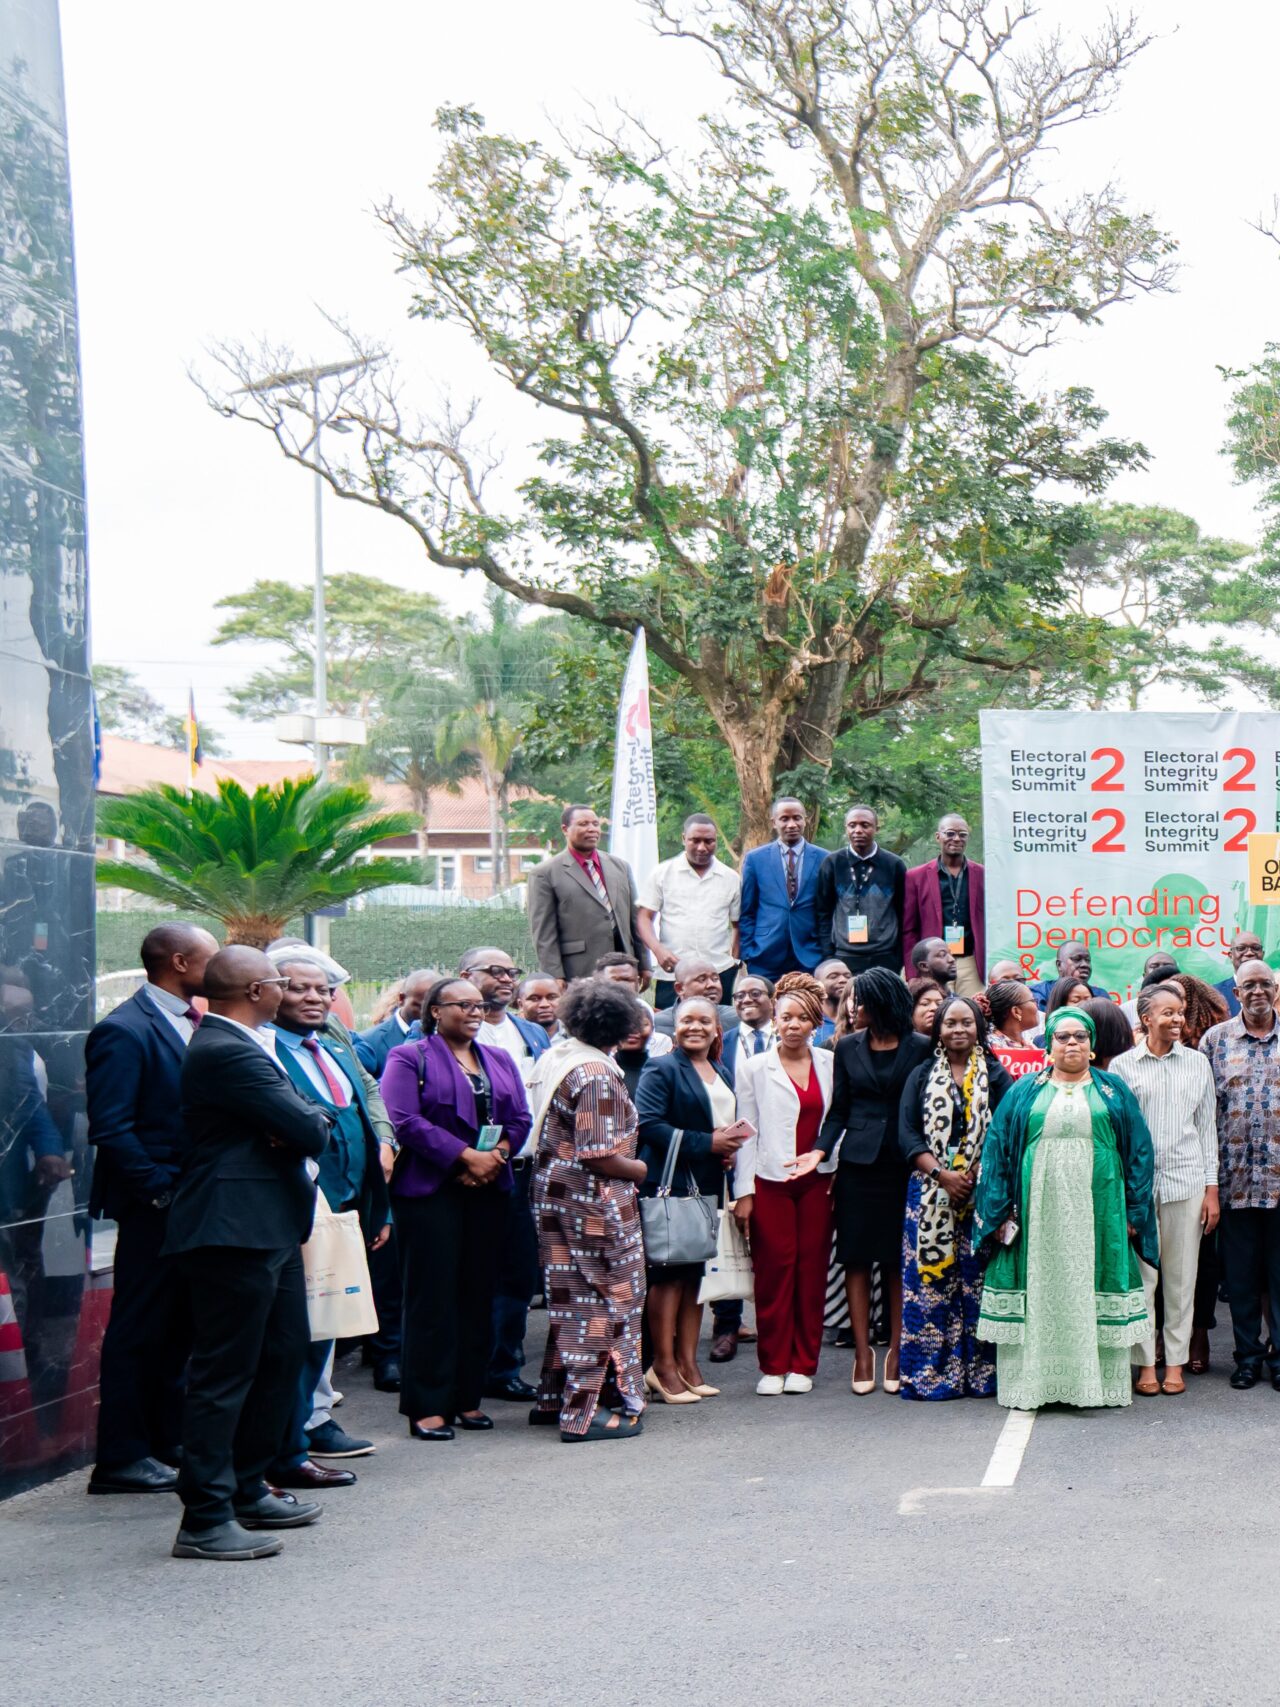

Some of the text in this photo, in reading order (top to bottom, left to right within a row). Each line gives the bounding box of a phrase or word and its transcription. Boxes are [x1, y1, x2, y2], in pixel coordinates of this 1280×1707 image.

[1010, 750, 1087, 762] Electoral
[1144, 750, 1218, 763] Electoral
[1011, 764, 1086, 780] Integrity
[1091, 747, 1125, 792] 2
[1144, 765, 1218, 781] Integrity
[1222, 747, 1256, 792] 2
[1011, 779, 1076, 792] Summit
[1144, 780, 1209, 792] Summit
[1013, 811, 1088, 823] Electoral
[1145, 811, 1219, 823] Electoral
[1013, 826, 1087, 841] Integrity
[1091, 808, 1126, 852] 2
[1145, 826, 1219, 841] Integrity
[1223, 808, 1257, 851] 2
[1013, 840, 1078, 853] Summit
[1145, 840, 1210, 852] Summit
[1016, 887, 1220, 924] Defending
[1016, 921, 1241, 955] Democracy
[1019, 953, 1041, 981] &
[999, 1054, 1049, 1076] Peopl
